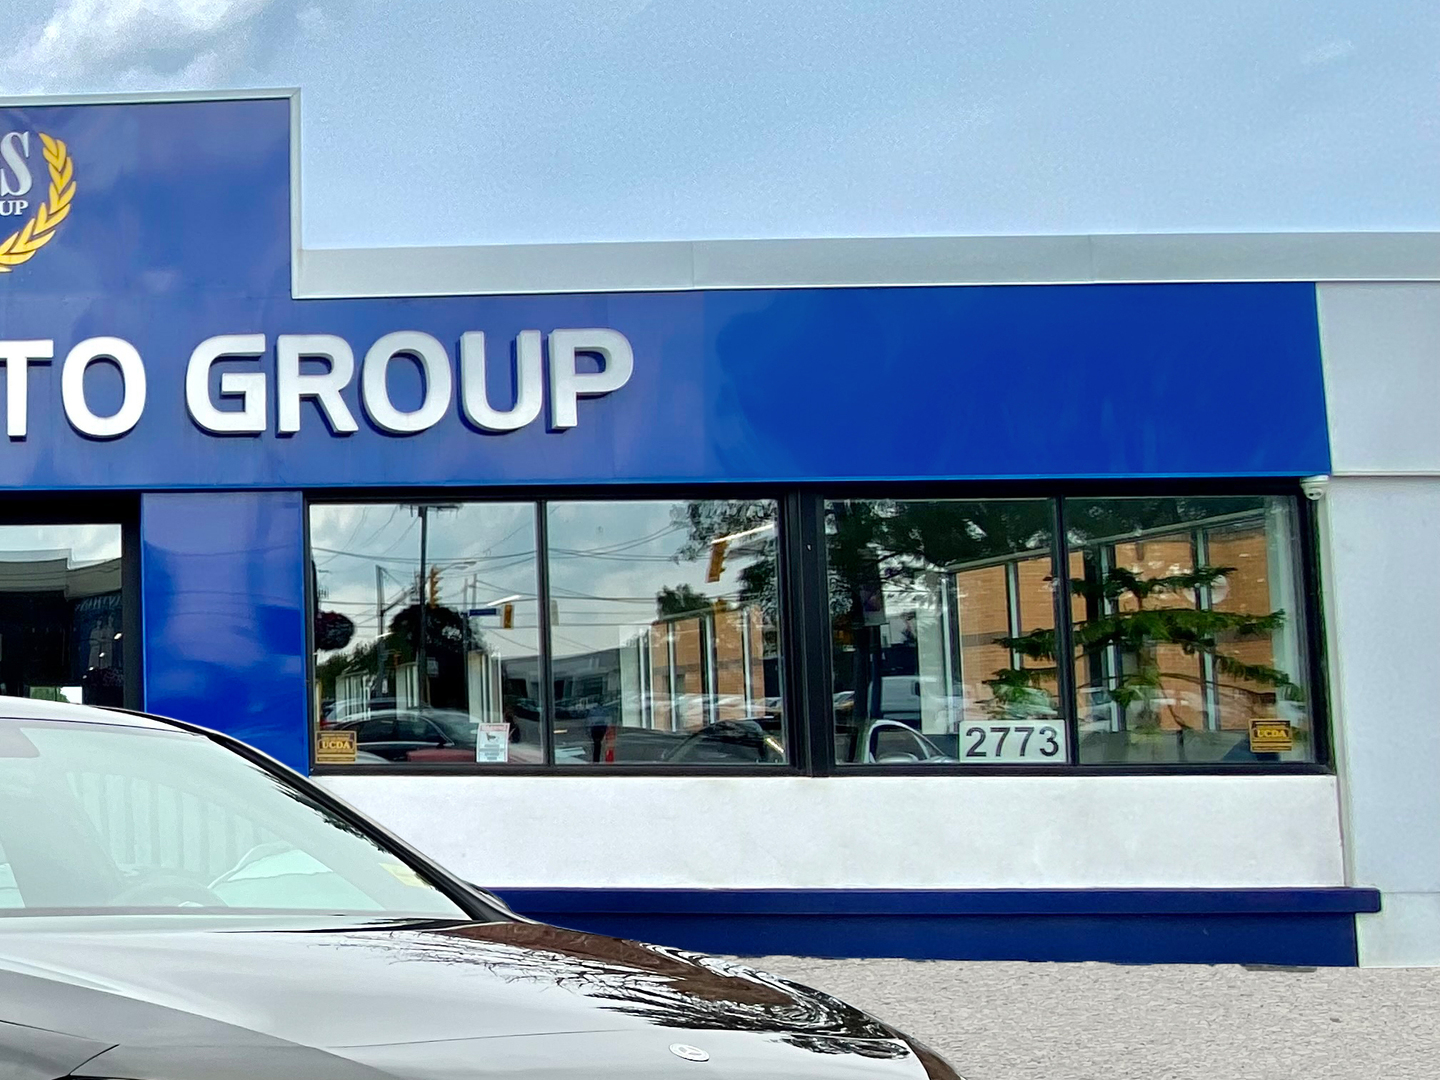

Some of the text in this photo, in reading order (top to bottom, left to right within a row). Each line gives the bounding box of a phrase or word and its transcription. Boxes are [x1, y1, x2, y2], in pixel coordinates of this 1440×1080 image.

[186, 328, 635, 436] GROUP
[322, 740, 351, 749] UCDA
[965, 725, 1060, 758] 2773
